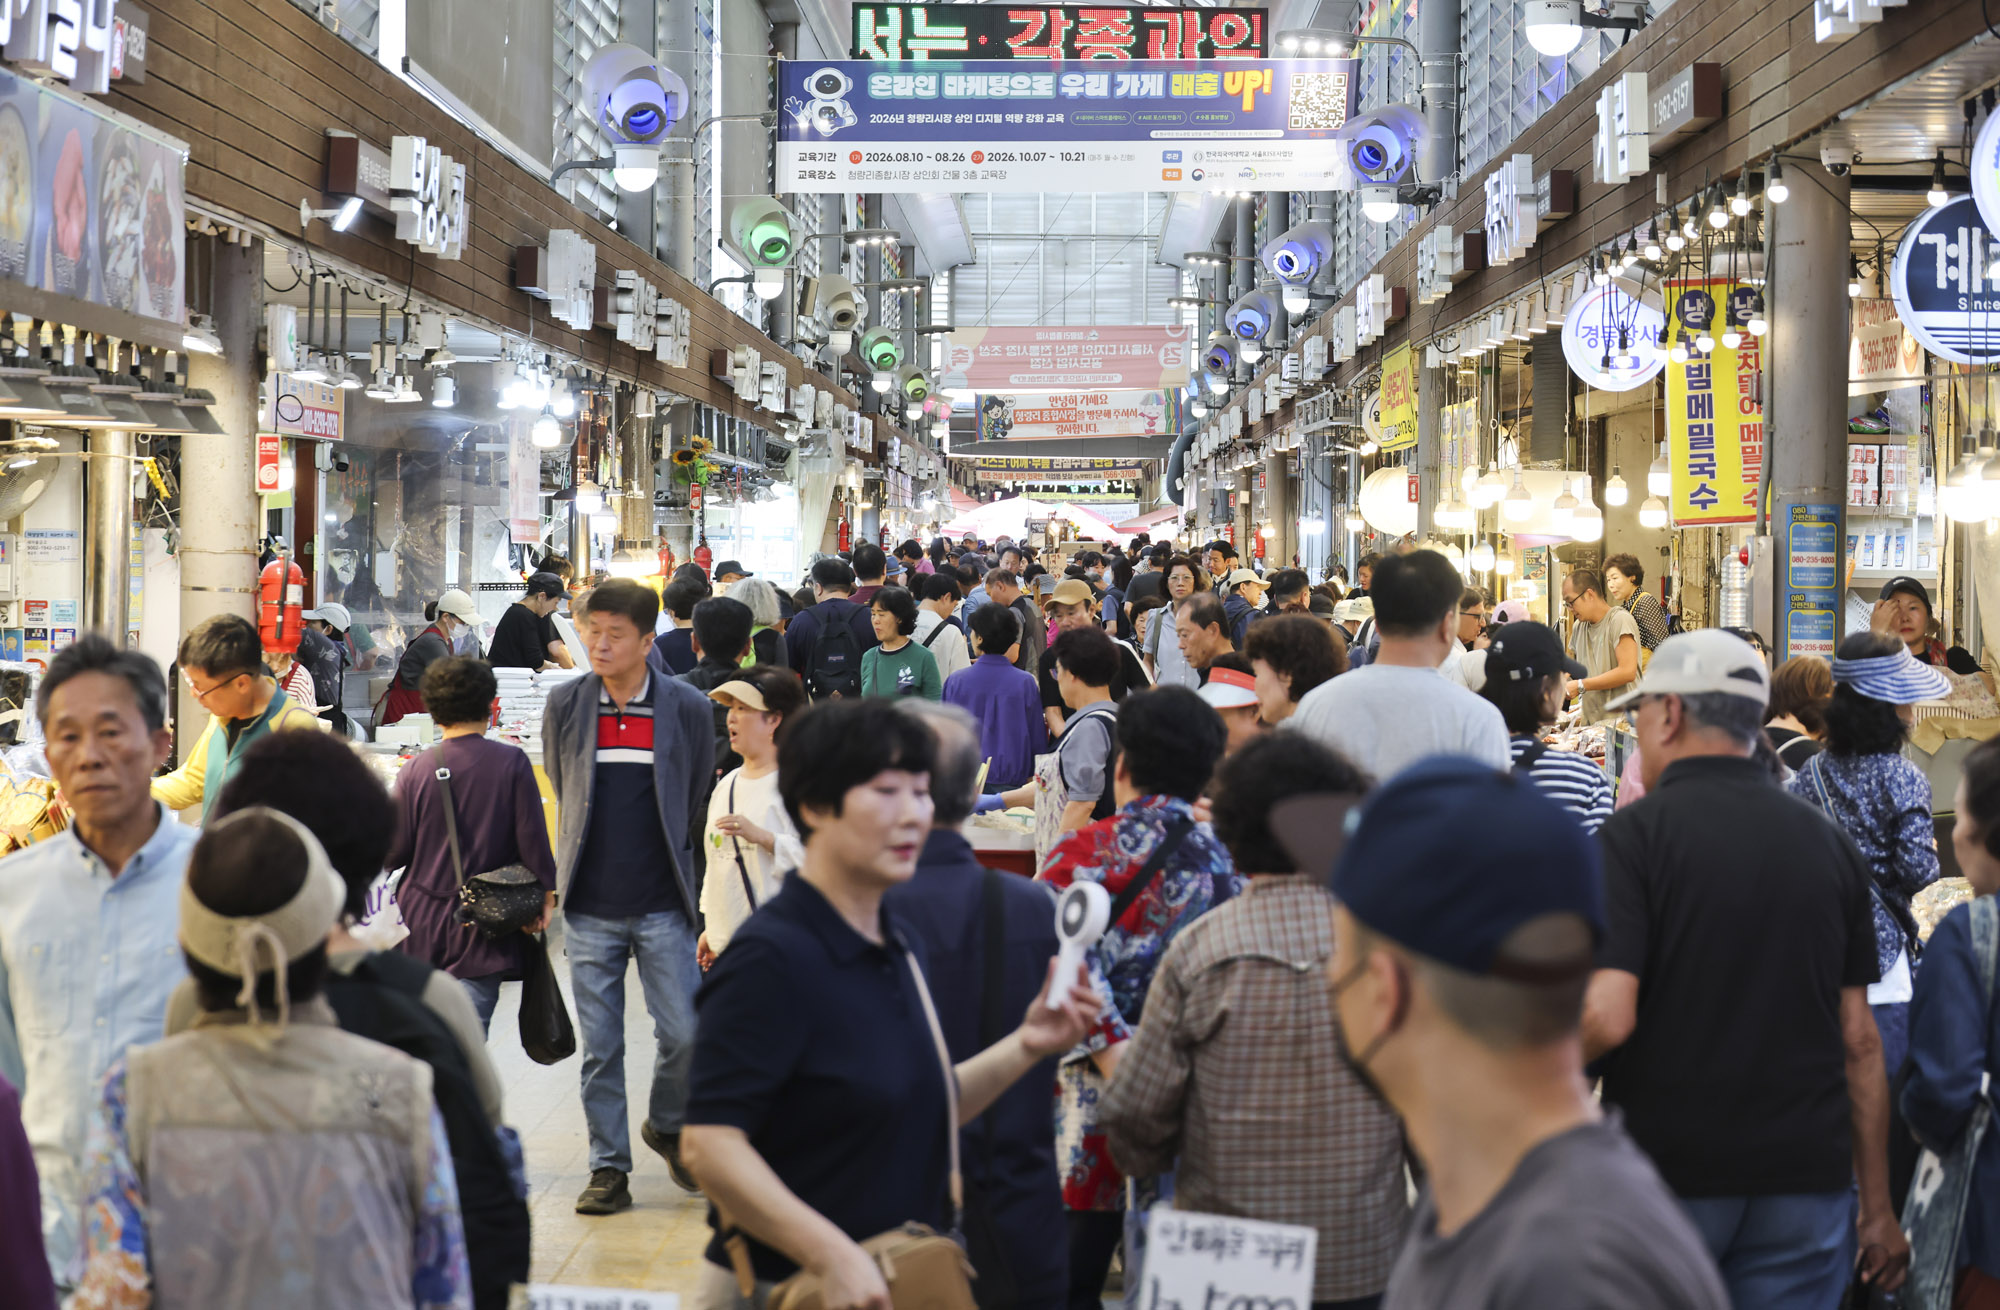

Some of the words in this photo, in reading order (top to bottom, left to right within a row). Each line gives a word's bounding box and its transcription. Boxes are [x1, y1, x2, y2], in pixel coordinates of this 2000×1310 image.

[868, 74, 938, 98] 온라인
[942, 74, 1056, 98] 마케팅으로
[1060, 73, 1110, 98] 우리
[1114, 73, 1165, 98] 가게
[1171, 72, 1220, 97] 매출
[1223, 68, 1274, 112] UP!
[870, 114, 905, 124] 2026년
[907, 114, 952, 124] 청량리시장
[954, 114, 973, 124] 상인
[975, 114, 1003, 124] 디지털
[1004, 114, 1024, 124] 역량
[1025, 114, 1044, 124] 강화
[1046, 114, 1065, 124] 교육
[797, 152, 837, 163] 교육기간
[865, 153, 923, 162] 2026.08.10
[934, 153, 966, 162] 08.26
[1059, 153, 1086, 162] 10.21
[797, 170, 837, 180] 교육장소
[848, 170, 911, 181] 청량리종합시장
[913, 170, 940, 180] 상인회
[942, 170, 961, 181] 건물
[962, 170, 978, 180] 3층
[980, 170, 1007, 181] 교육장
[1049, 395, 1078, 408] 안녕히
[1079, 394, 1109, 405] 가세요
[1015, 409, 1041, 422] 청량리
[1086, 409, 1112, 420] 방문해
[1792, 506, 1807, 514] 080
[1790, 594, 1805, 602] 080
[1790, 643, 1833, 651] 080-235-9203
